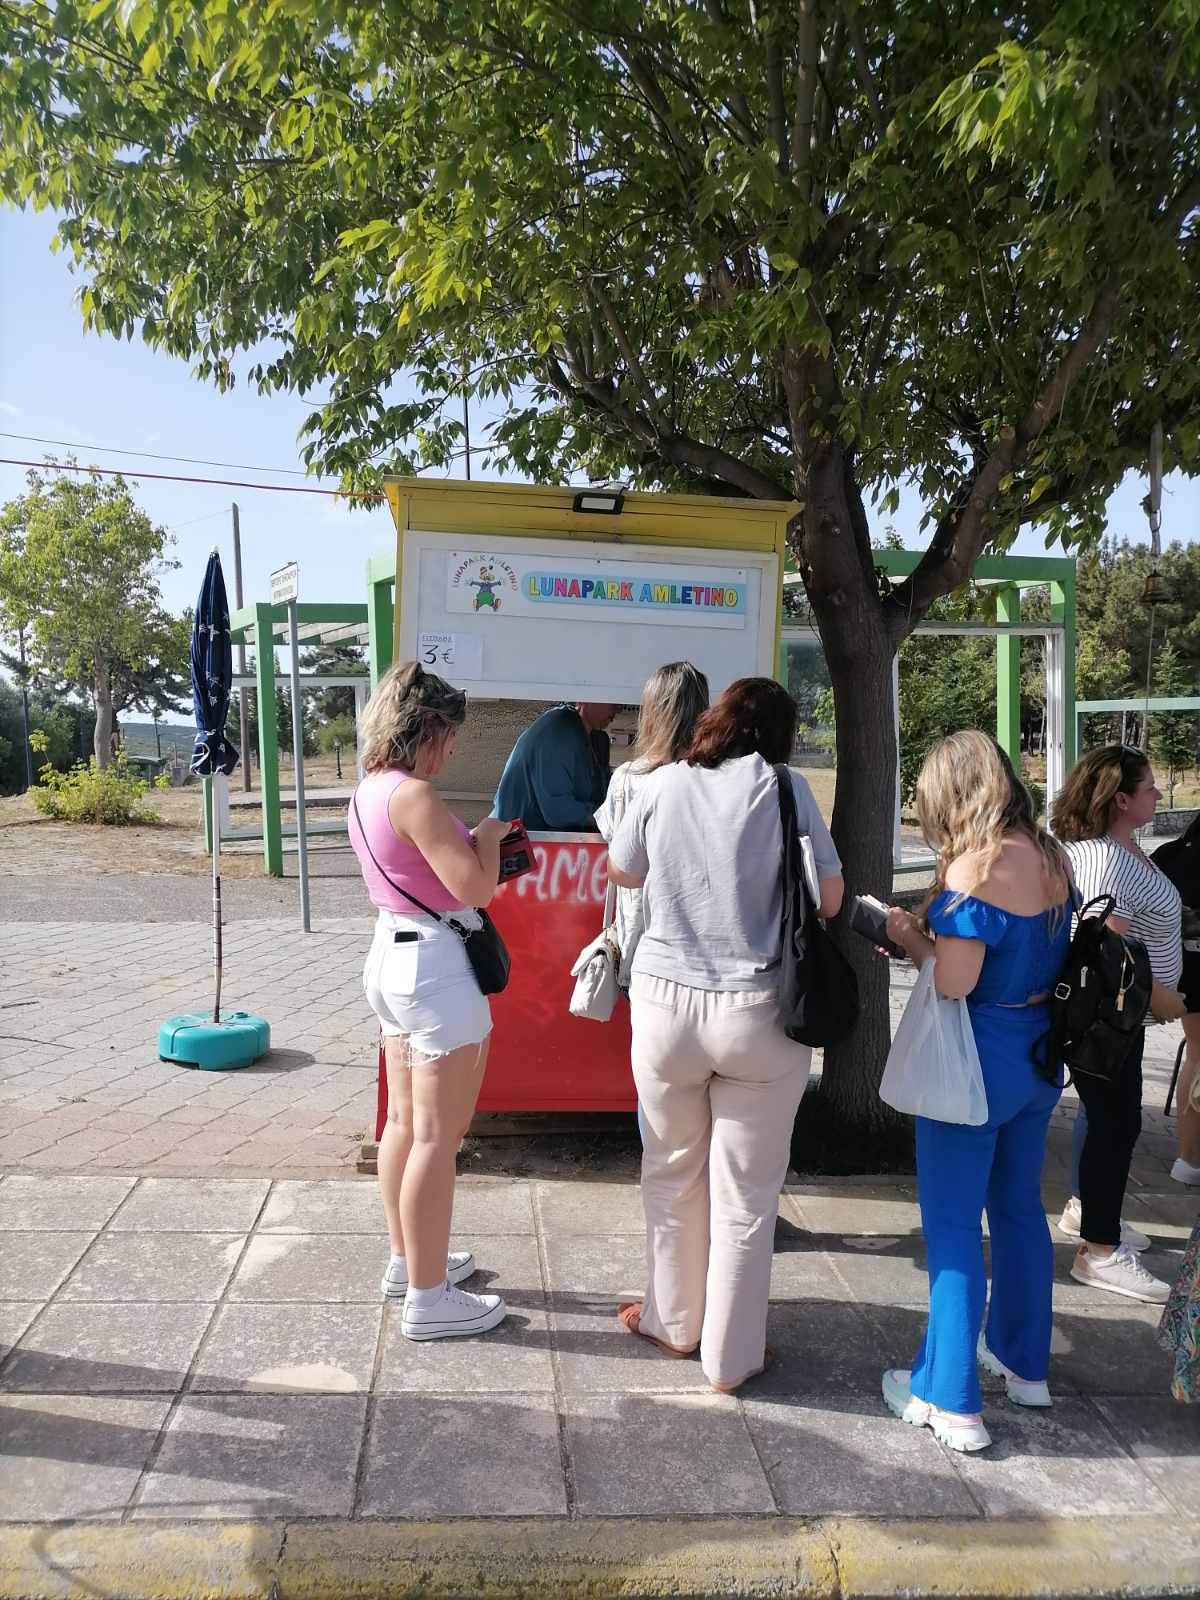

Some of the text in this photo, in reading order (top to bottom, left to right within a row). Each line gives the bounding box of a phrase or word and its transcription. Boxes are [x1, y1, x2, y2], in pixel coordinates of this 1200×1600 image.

[529, 576, 739, 609] LUNAPARK AMLETINO
[495, 846, 609, 902] AME
